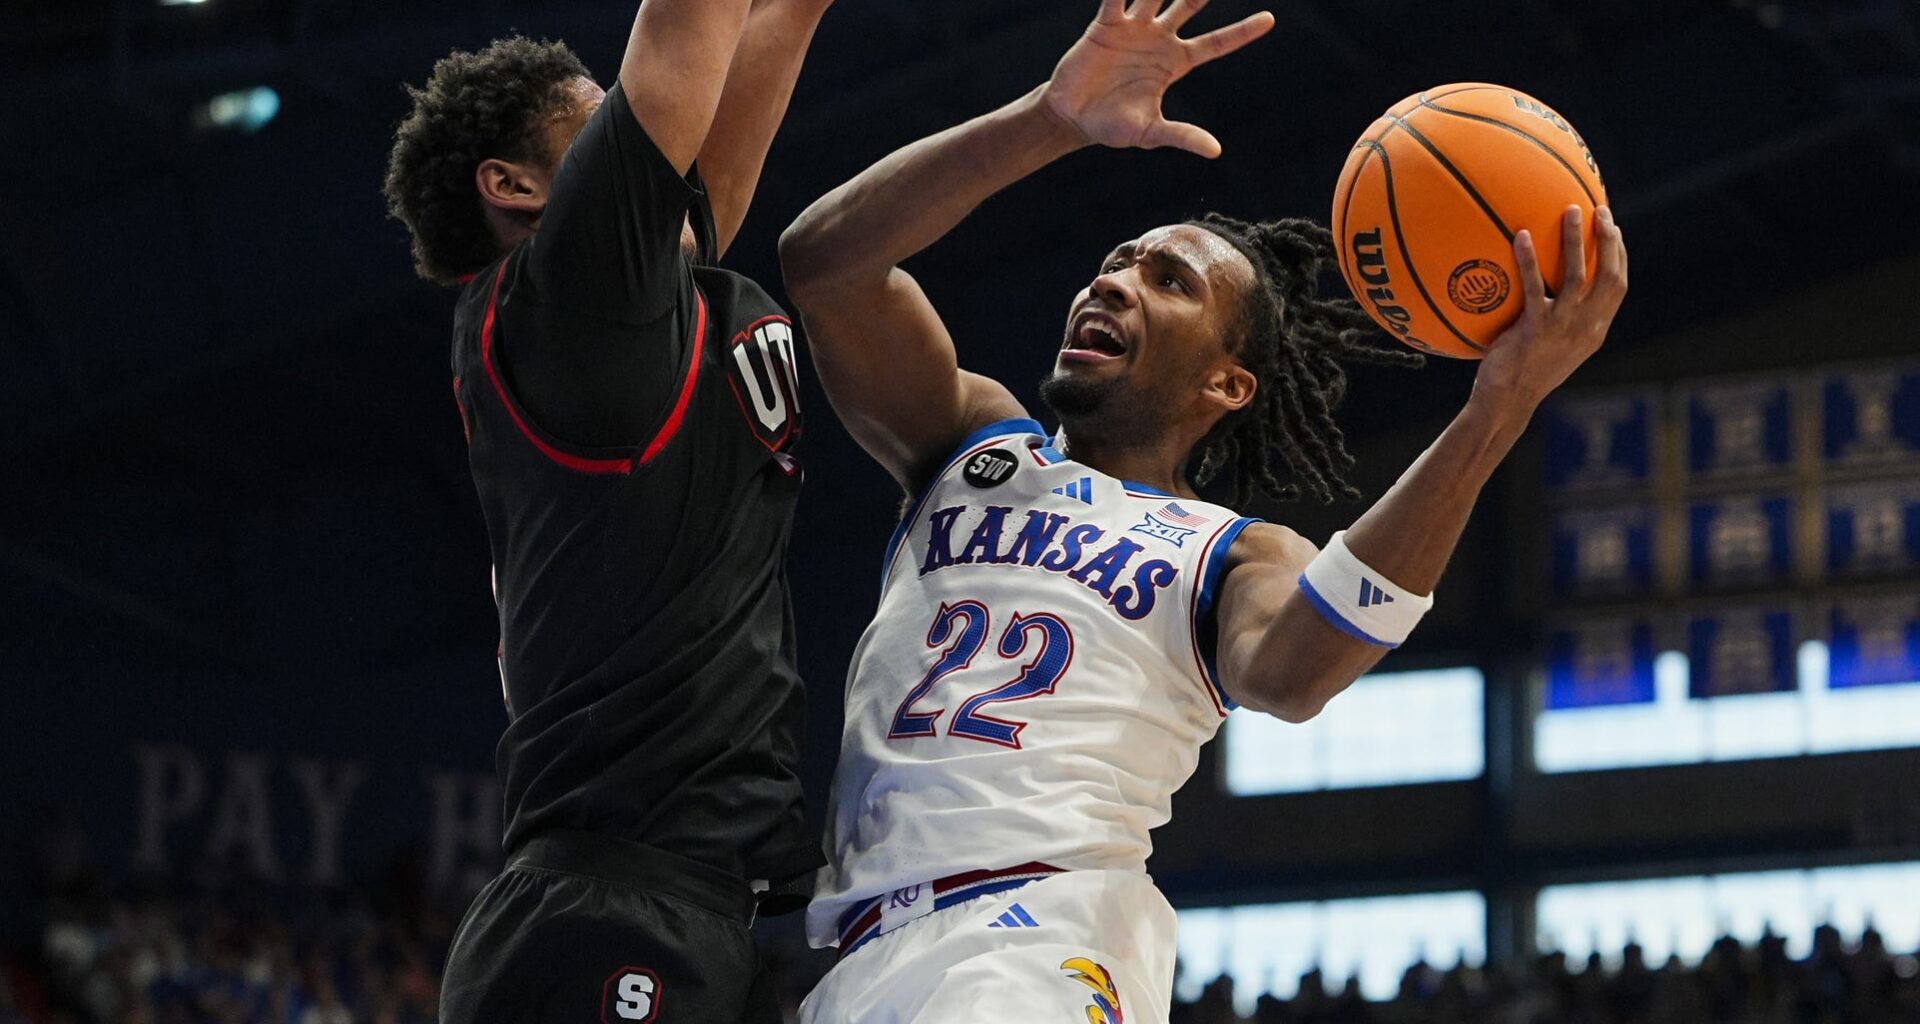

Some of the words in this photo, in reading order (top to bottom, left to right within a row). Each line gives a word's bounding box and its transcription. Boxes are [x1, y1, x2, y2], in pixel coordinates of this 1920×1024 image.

[1352, 226, 1434, 352] Wilso
[732, 321, 800, 432] UT
[968, 453, 1014, 480] SW
[919, 504, 1180, 620] KANSAS
[887, 599, 1075, 750] 22
[129, 740, 367, 888] PAY
[615, 972, 655, 1020] S
